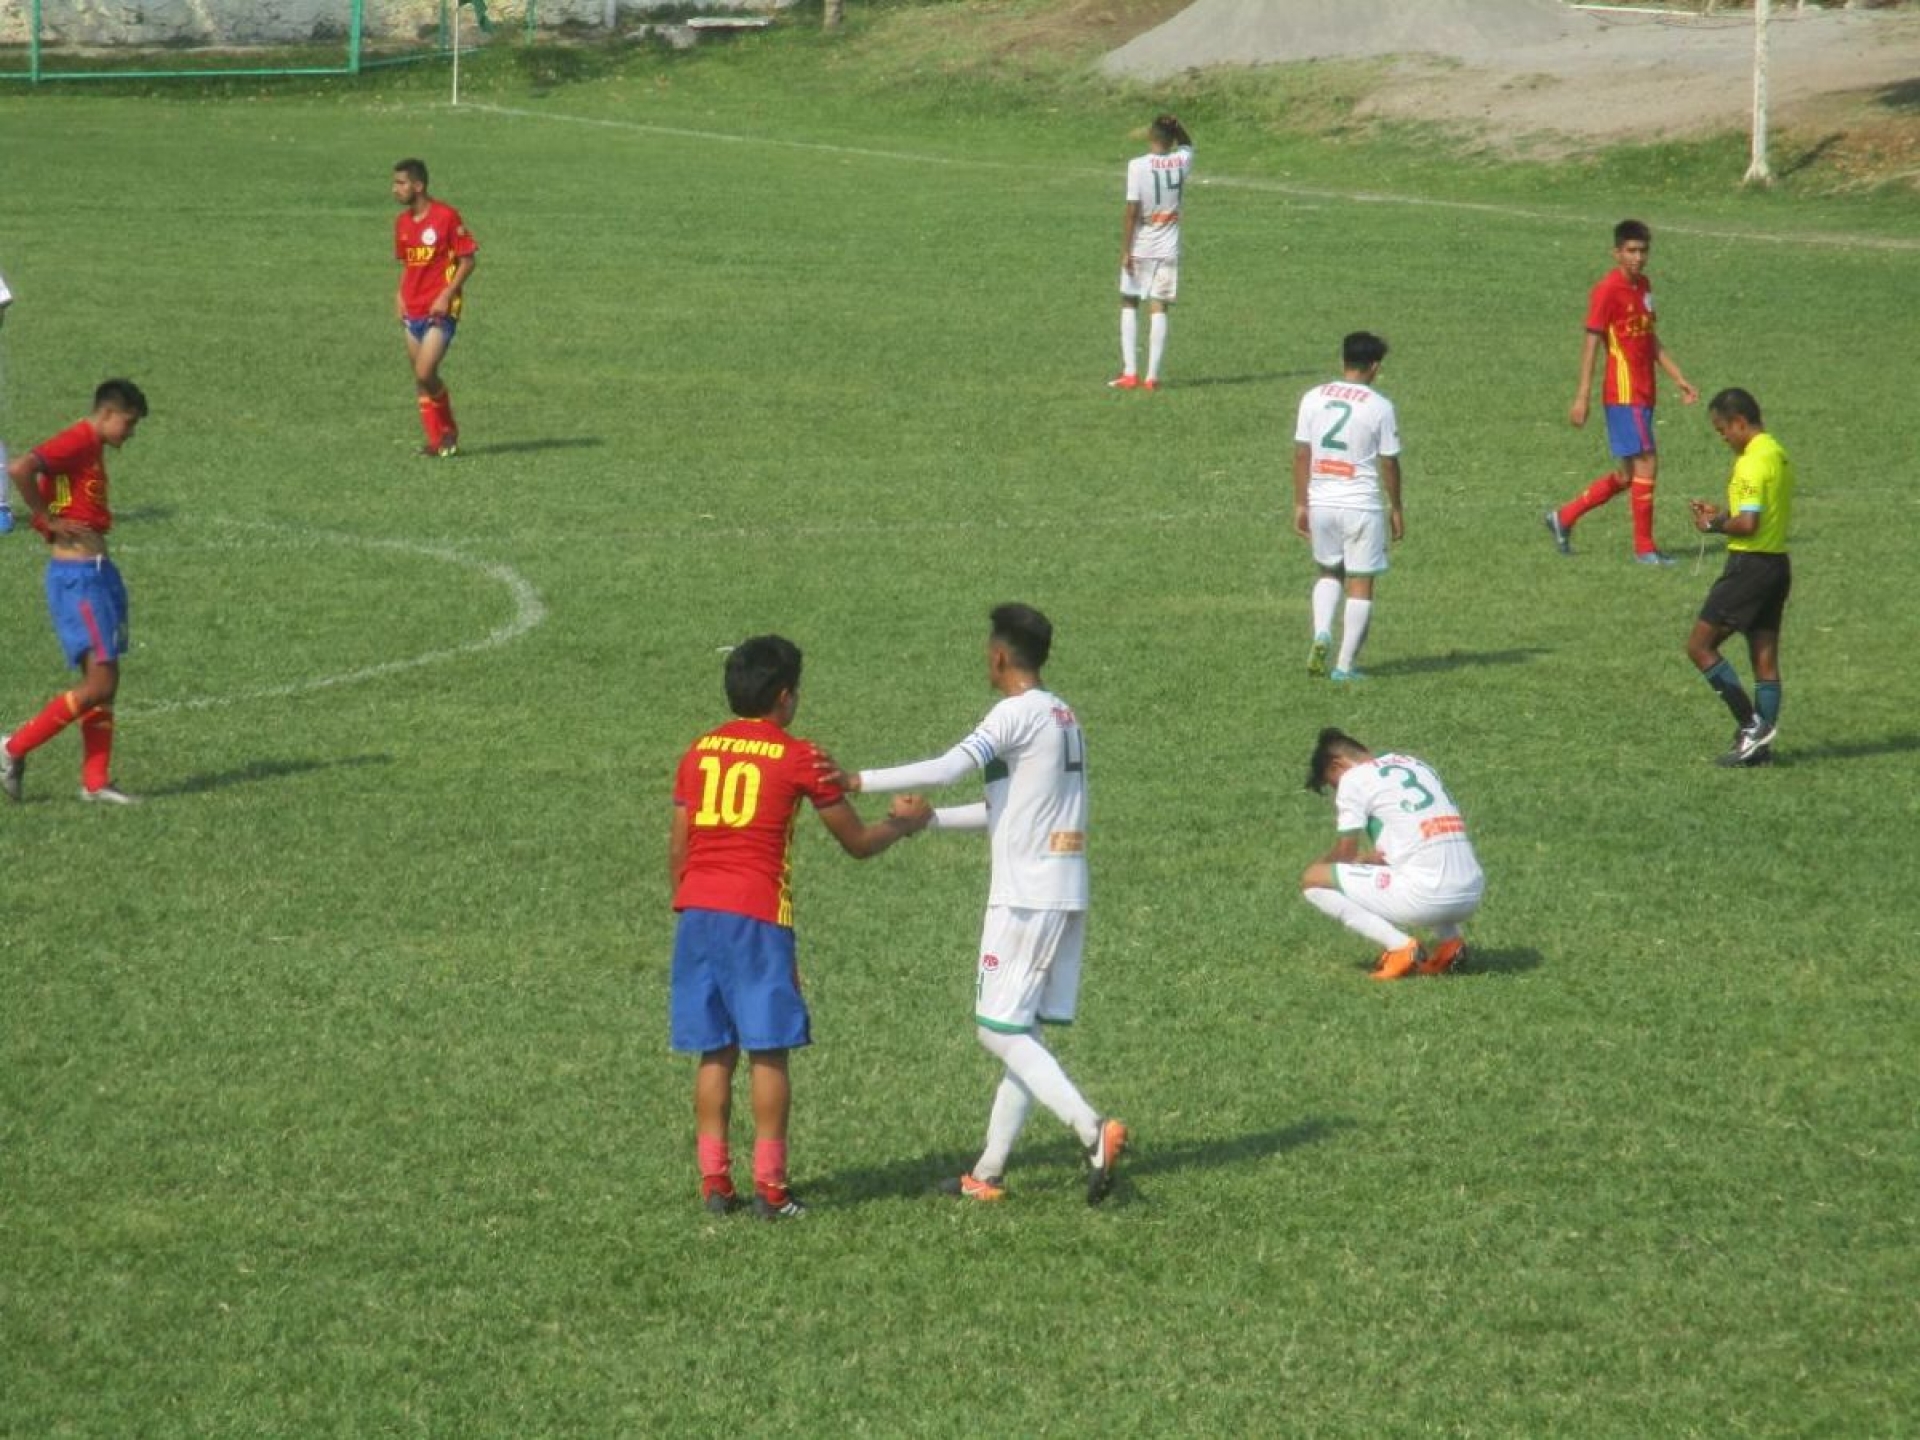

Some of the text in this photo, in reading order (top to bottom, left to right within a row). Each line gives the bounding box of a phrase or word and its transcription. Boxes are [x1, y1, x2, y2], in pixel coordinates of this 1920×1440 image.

[1151, 169, 1183, 206] 14
[1320, 399, 1353, 451] 2
[696, 735, 785, 759] ANTONIO
[1063, 728, 1084, 775] 4
[695, 756, 761, 828] 10
[1379, 764, 1435, 812] 3
